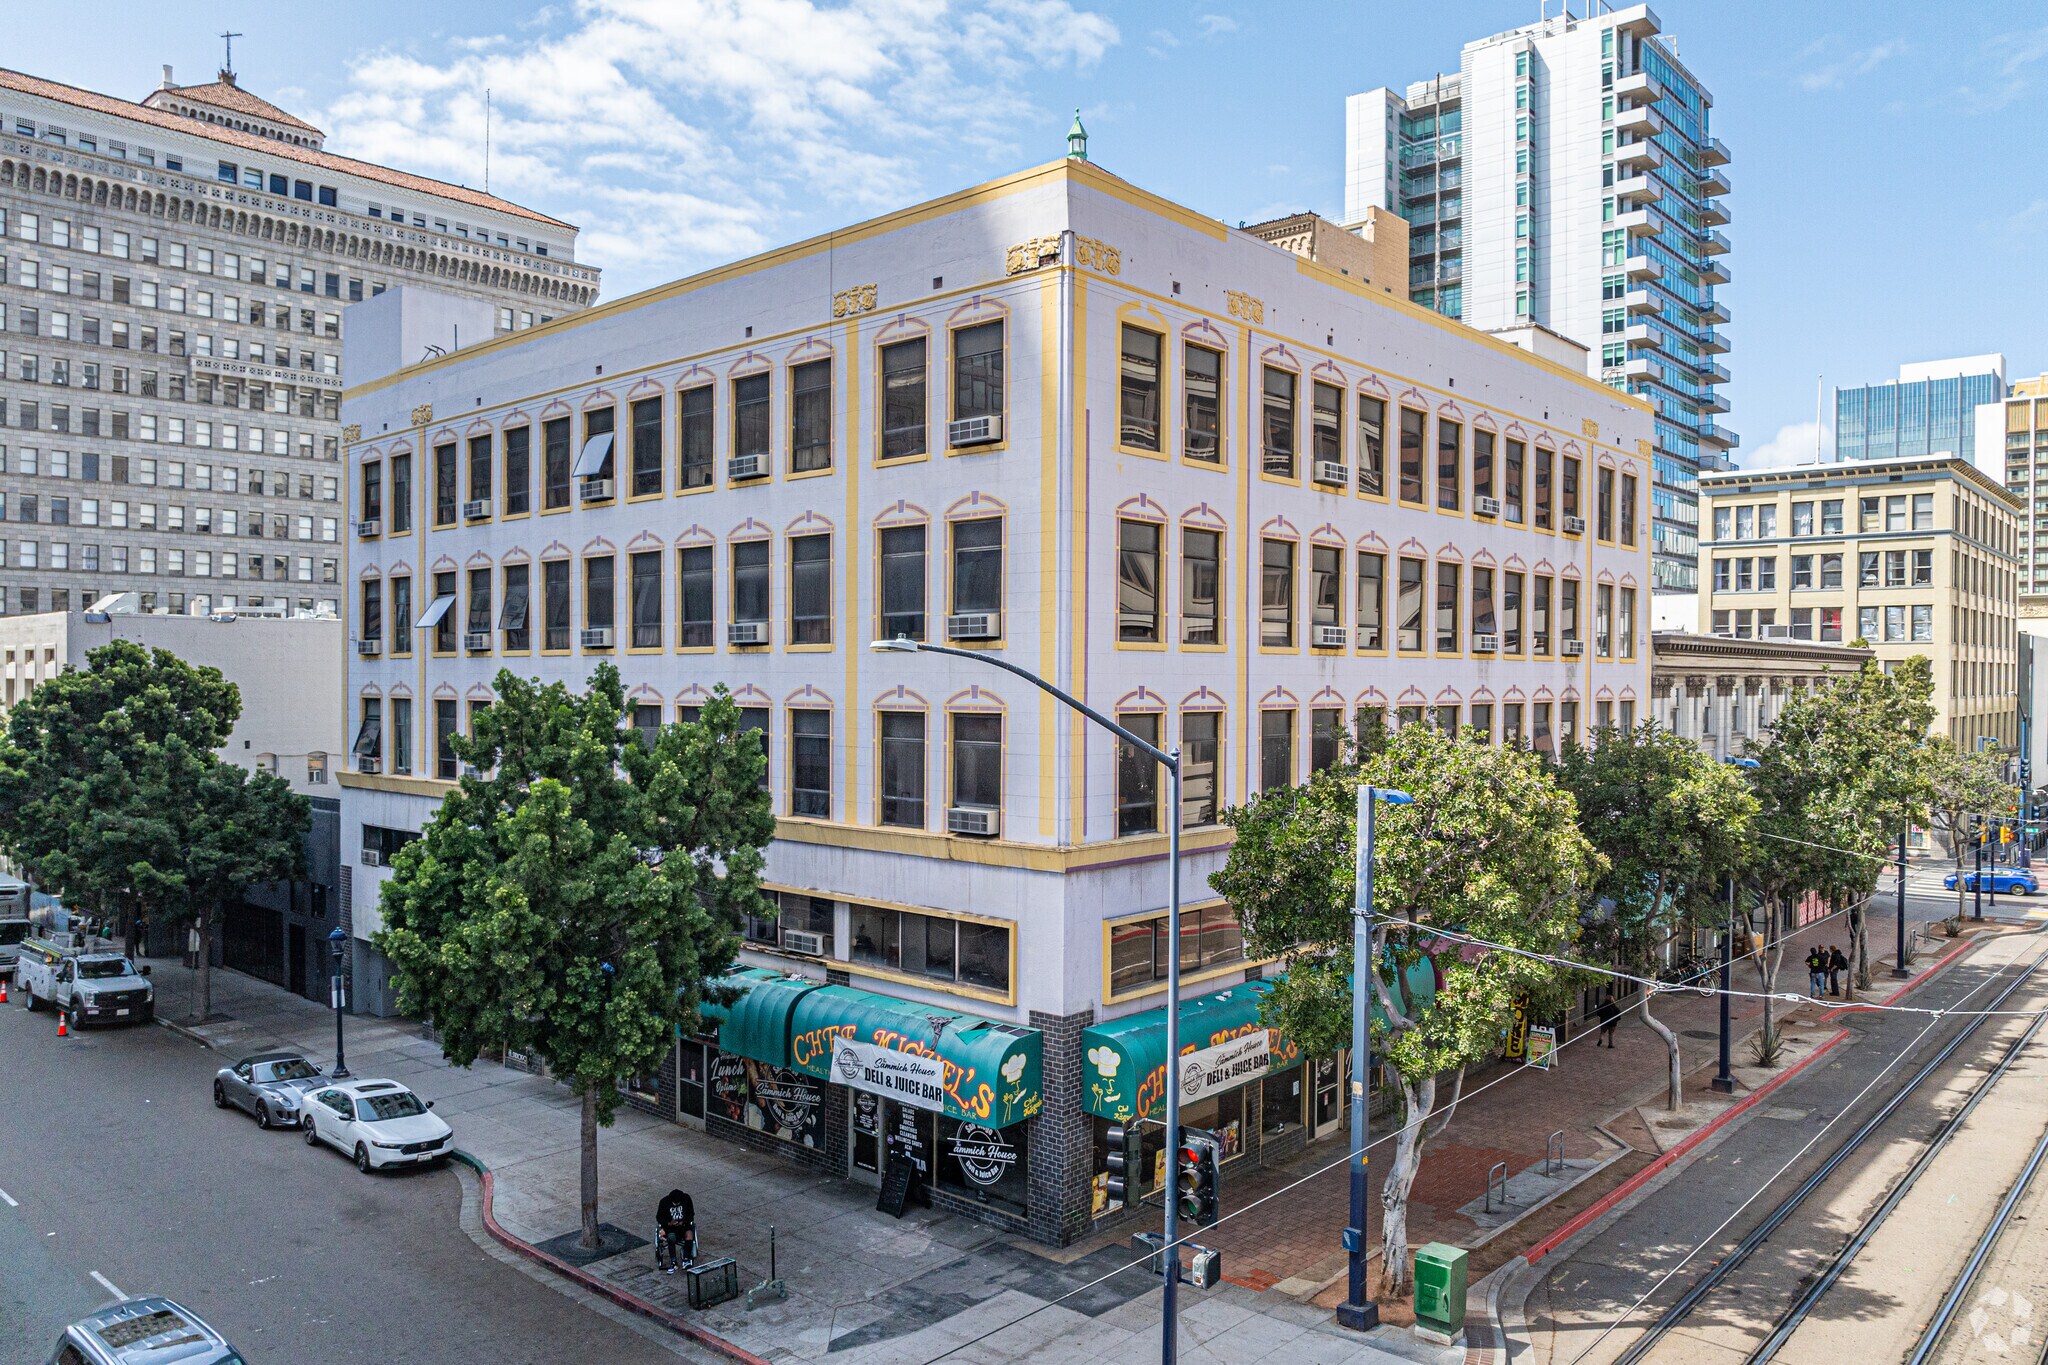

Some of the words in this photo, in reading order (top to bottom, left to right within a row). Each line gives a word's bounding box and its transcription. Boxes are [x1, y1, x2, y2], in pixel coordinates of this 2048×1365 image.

[1215, 1046, 1243, 1069] Sammich
[1243, 1039, 1263, 1055] House
[710, 1057, 745, 1081] Lunch
[873, 1057, 908, 1073] Sammich
[910, 1062, 937, 1077] House
[1206, 1068, 1224, 1087] DELI
[1224, 1068, 1230, 1080] &
[1231, 1058, 1252, 1078] JUICE
[1253, 1053, 1269, 1070] BAR
[755, 1082, 792, 1099] Sammich
[793, 1086, 821, 1102] House
[864, 1067, 884, 1085] DELI
[885, 1075, 893, 1089] &
[894, 1075, 920, 1096] JUICE
[921, 1082, 943, 1103] BAR
[902, 1113, 915, 1121] WRAPS
[961, 1109, 977, 1120] BAR
[987, 1145, 1018, 1161] House
[965, 1160, 976, 1174] Deli
